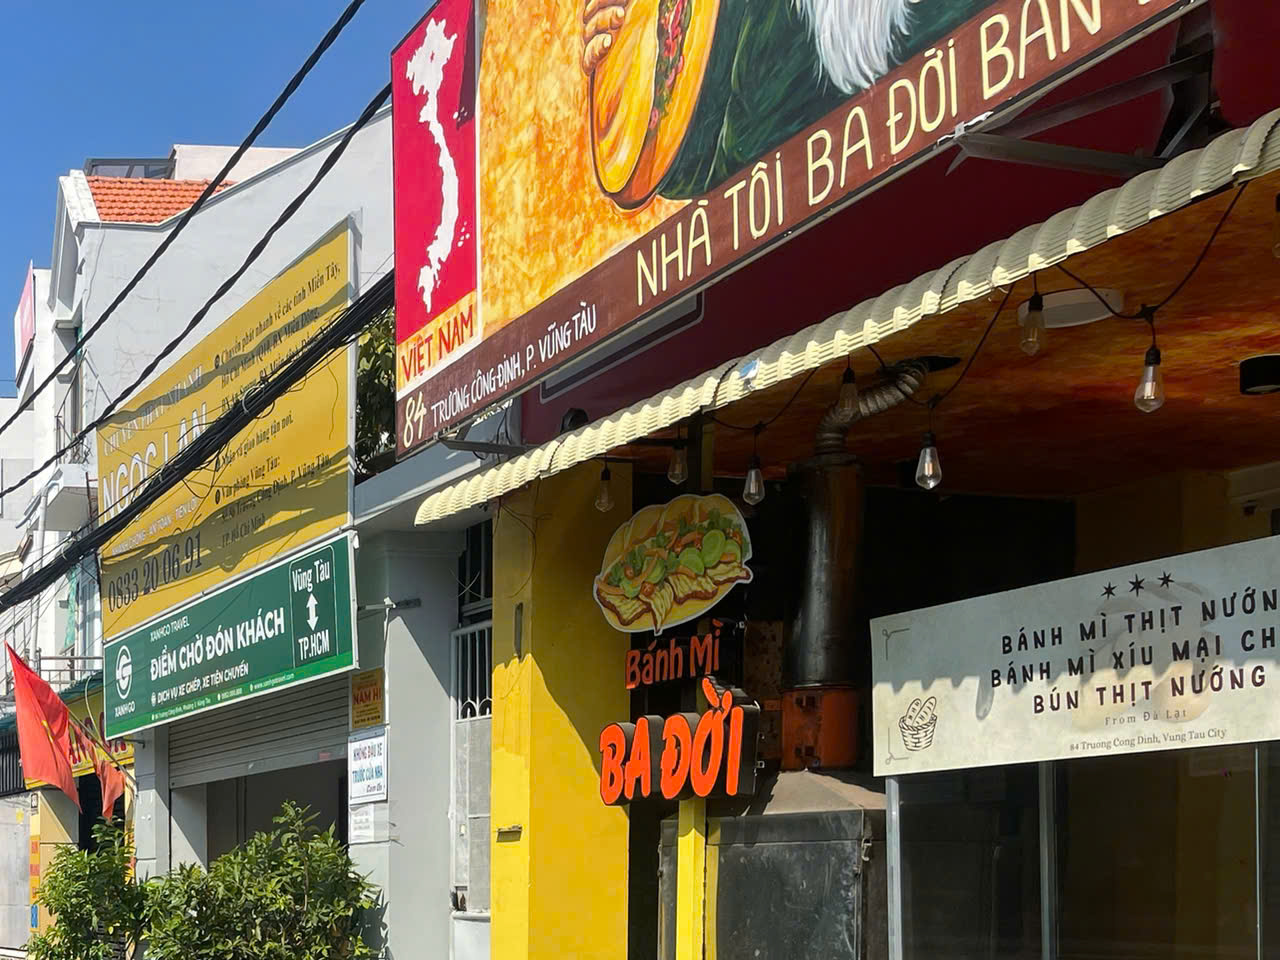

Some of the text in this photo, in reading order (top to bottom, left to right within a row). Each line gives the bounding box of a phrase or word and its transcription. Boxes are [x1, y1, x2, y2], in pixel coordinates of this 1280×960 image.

[636, 200, 712, 306] NHÀ
[724, 152, 784, 250] TÔI
[806, 105, 874, 206] BA
[886, 37, 958, 156] ĐỜI
[401, 304, 474, 382] VIỆT NAM
[403, 391, 427, 448] 84
[470, 370, 496, 404] CÔNG
[494, 352, 525, 390] ĐỊNH,
[526, 344, 537, 371] P.
[538, 321, 571, 362] VŨNG
[572, 301, 596, 341] TÀU
[108, 530, 202, 613] 0833 20 06 91
[292, 559, 331, 593] Vũng Tàu
[150, 607, 285, 681] ĐIỂM CHỜ ĐÓN KHÁCH
[298, 628, 330, 661] TP.HCM
[625, 618, 724, 690] Bánh Mì
[991, 626, 1276, 688] BÁNH MÌ XÍU MẠI CH
[1001, 626, 1063, 655] BÁNH
[1080, 612, 1107, 642] MÌ
[1123, 605, 1183, 633] THỊT
[1033, 664, 1266, 714] BÚN THỊT NƯỚNG
[1105, 709, 1187, 726] From Đà Lạt
[599, 677, 744, 806] BA ĐỜI
[1070, 727, 1228, 751] 84 Truong Cong Dinh, Vung Tau City
